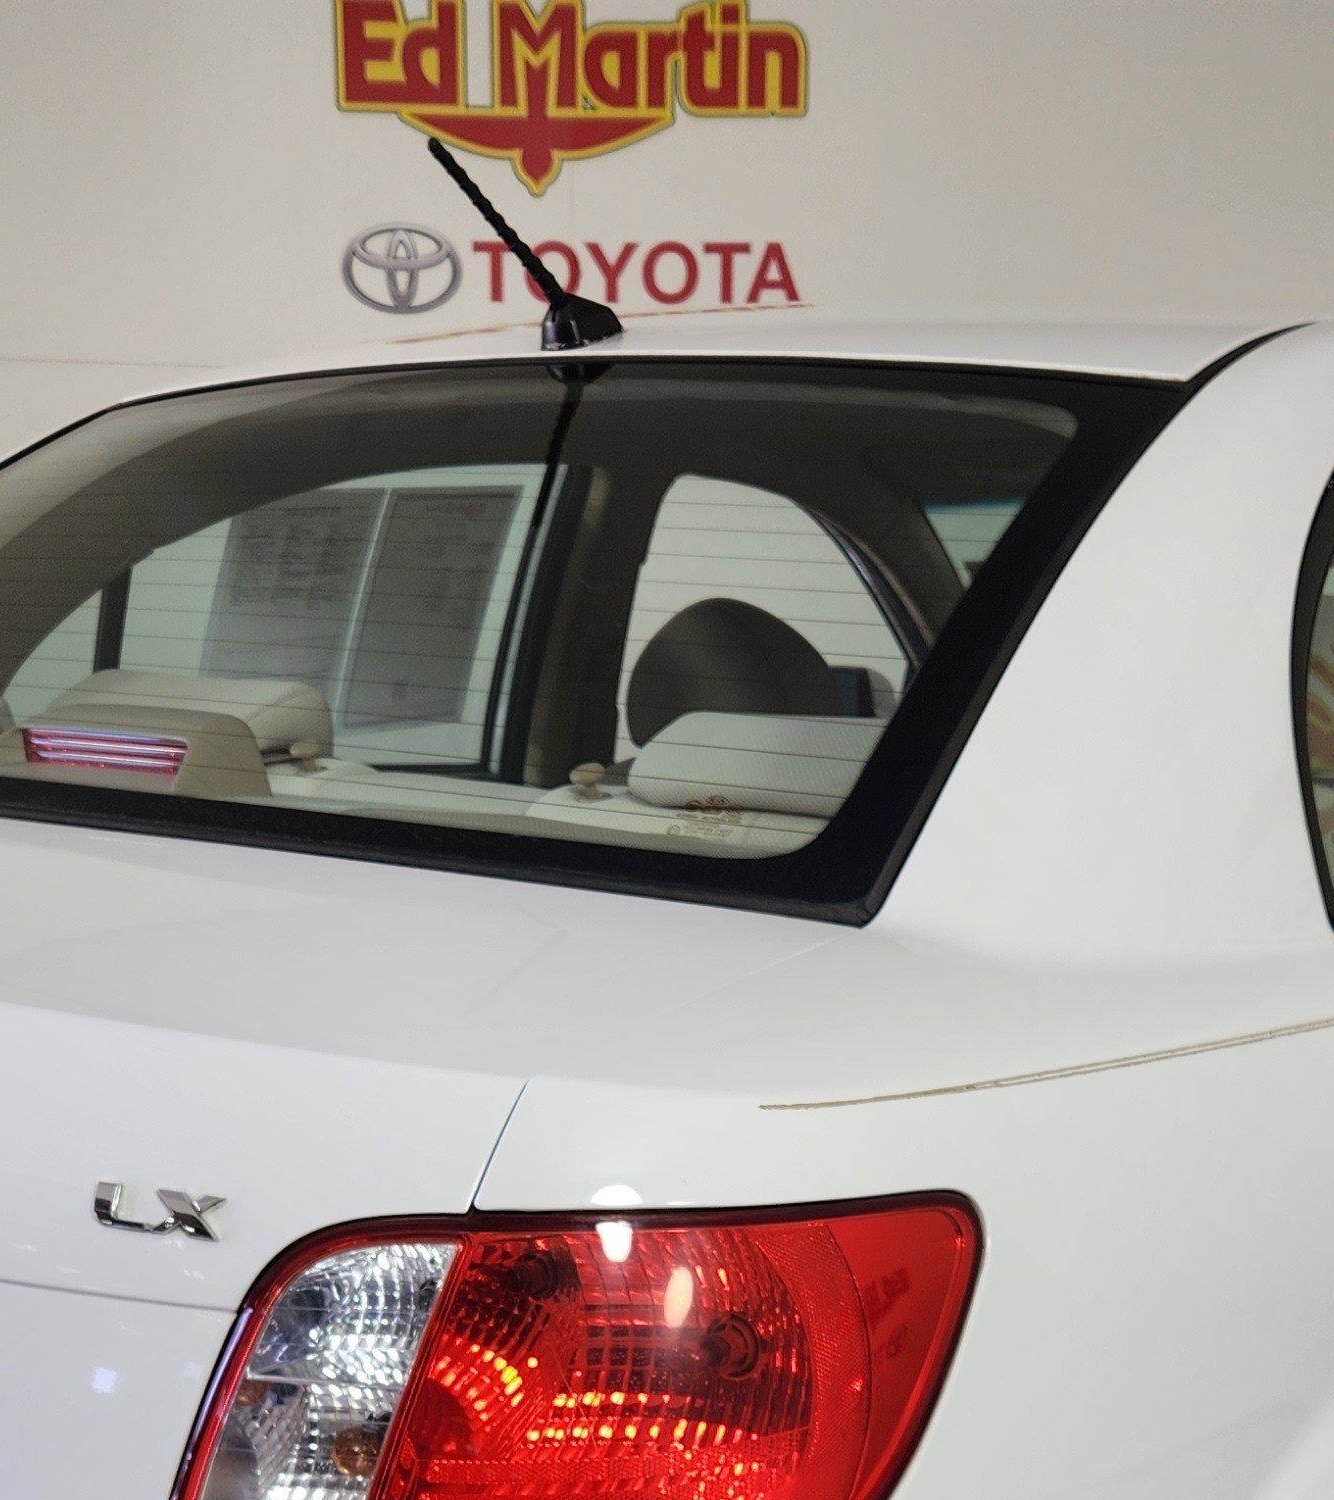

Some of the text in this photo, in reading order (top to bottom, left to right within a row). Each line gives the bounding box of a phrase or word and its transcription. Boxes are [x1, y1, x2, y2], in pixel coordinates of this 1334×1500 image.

[336, 0, 808, 115] Ed Martin
[473, 241, 800, 304] TOYOTA
[94, 1181, 227, 1242] LX
